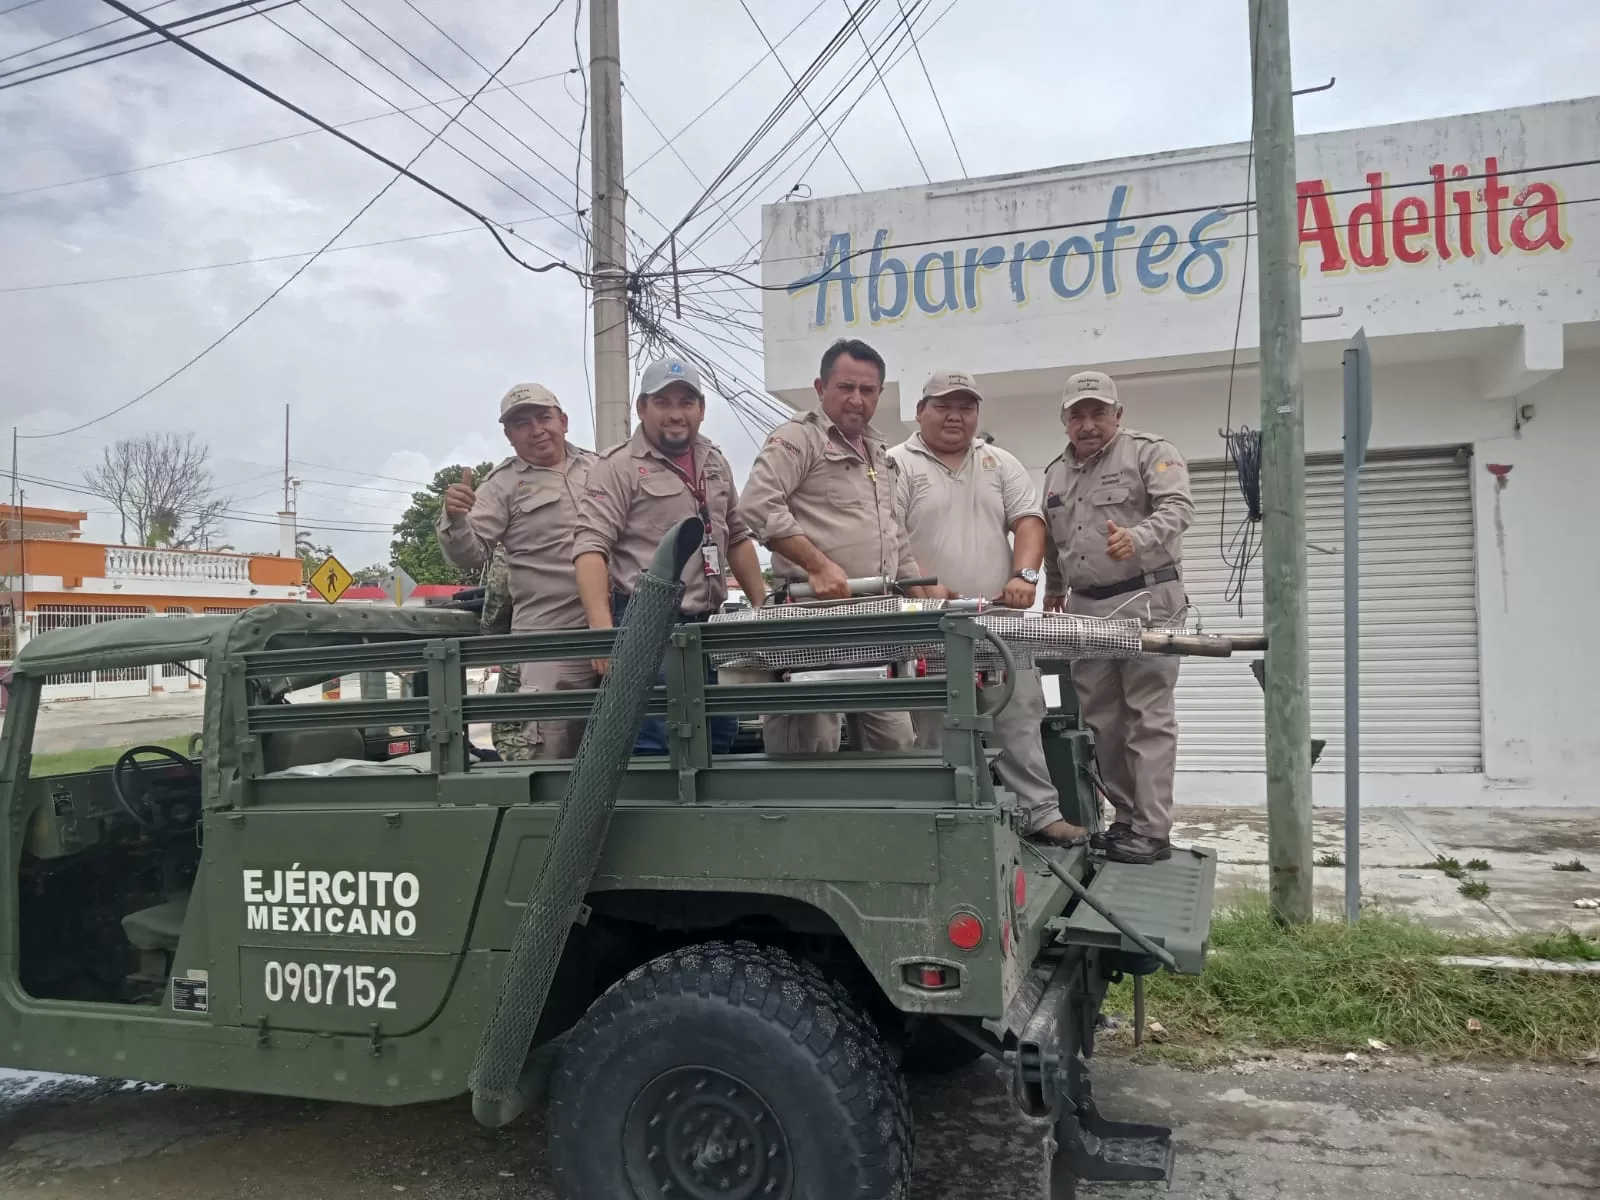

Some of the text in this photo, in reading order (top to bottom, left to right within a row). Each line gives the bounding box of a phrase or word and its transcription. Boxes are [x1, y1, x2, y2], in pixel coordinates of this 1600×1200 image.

[787, 157, 1565, 327] Abarrotes Adelita
[243, 862, 420, 907] EJÉRCITO
[247, 905, 417, 936] MEXICANO
[265, 961, 398, 1009] 0907152
